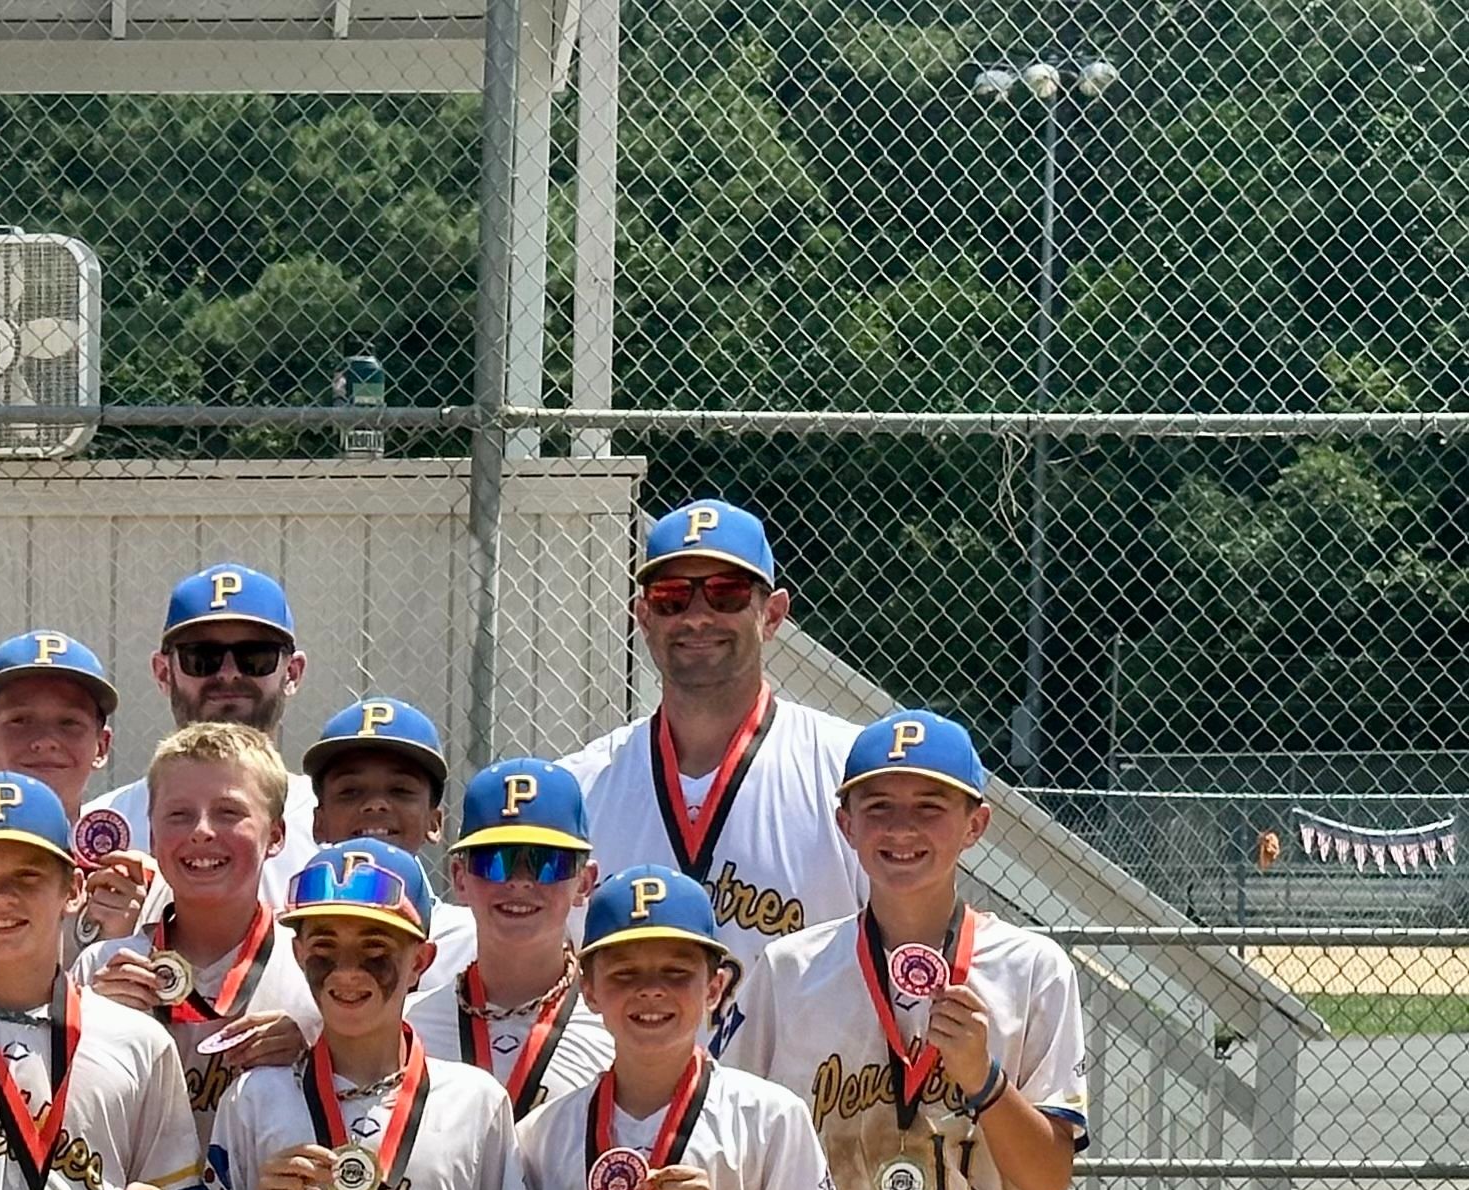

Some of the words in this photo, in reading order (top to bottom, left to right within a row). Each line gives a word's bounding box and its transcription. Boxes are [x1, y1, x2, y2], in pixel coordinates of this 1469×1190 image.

[684, 507, 719, 543] P
[210, 572, 243, 610] P
[33, 633, 68, 665] P
[358, 701, 394, 738] P
[887, 721, 925, 761] P
[501, 774, 538, 818] P
[629, 876, 667, 920] P
